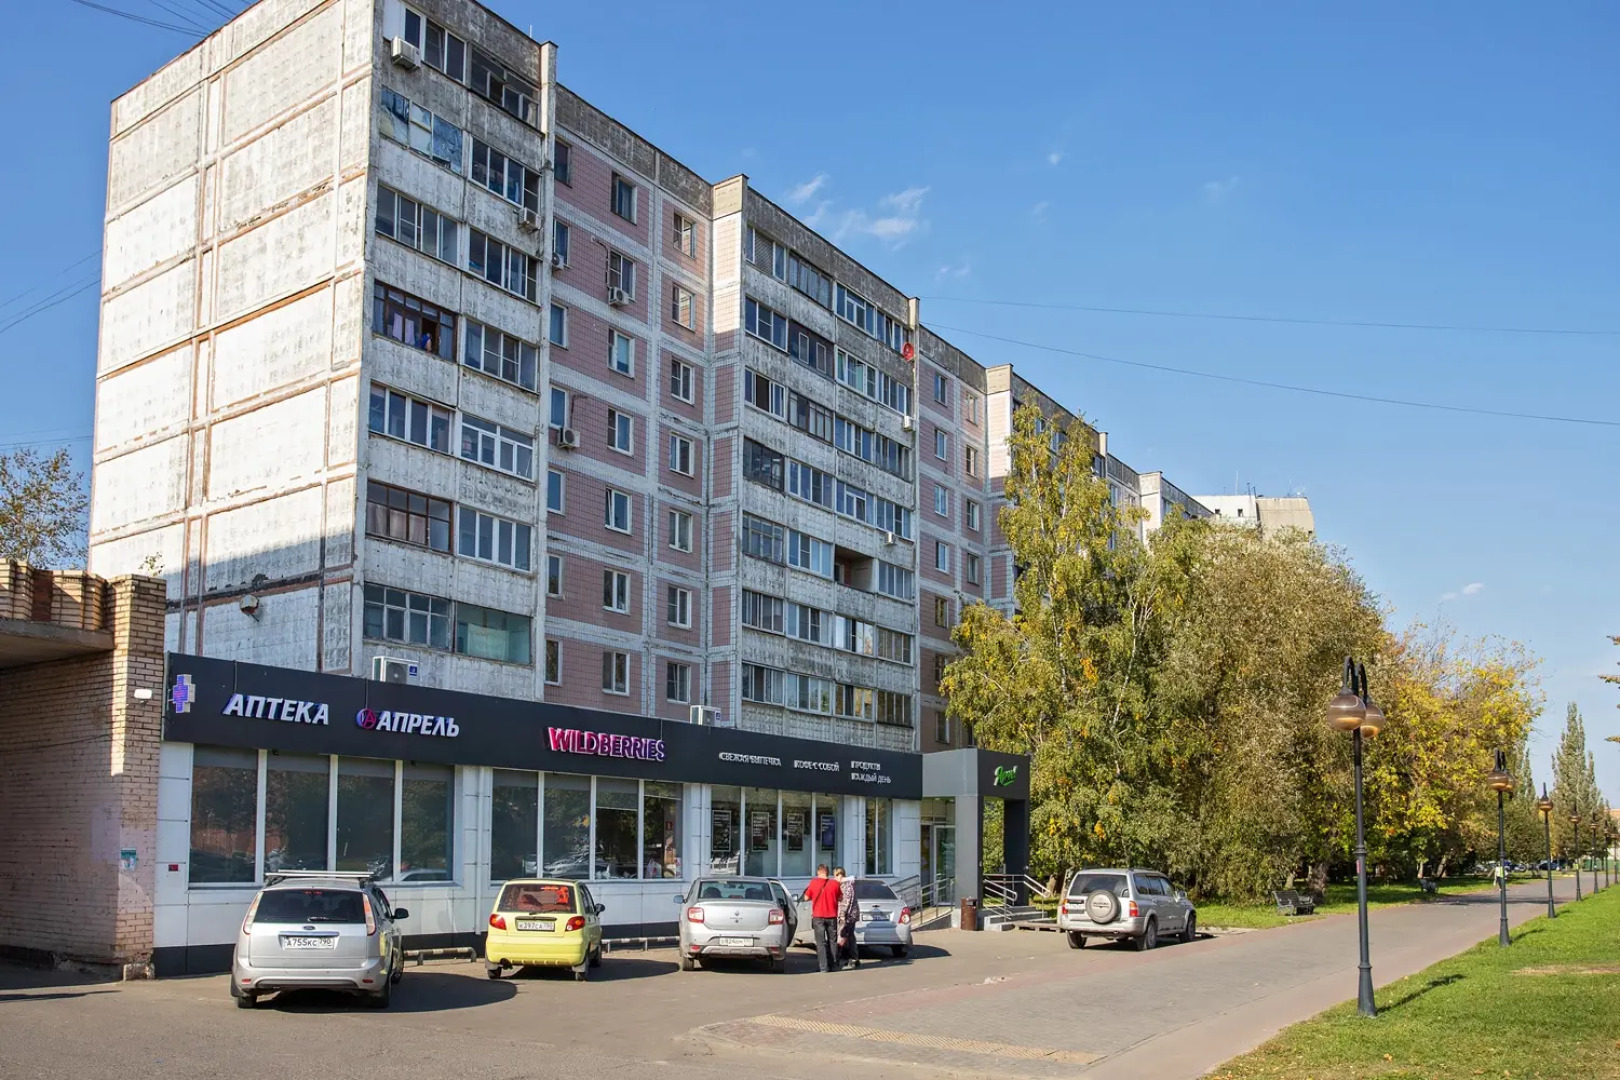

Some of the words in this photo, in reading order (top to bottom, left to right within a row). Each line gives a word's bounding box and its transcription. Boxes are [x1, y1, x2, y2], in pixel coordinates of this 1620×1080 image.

[222, 693, 329, 725] АПТЕКА
[376, 710, 460, 738] АПРЕЛЬ
[547, 726, 666, 762] WILDBERRIES
[794, 760, 812, 770] КОФЕ
[818, 761, 840, 772] СОБОЙ
[851, 772, 877, 782] КАЖДЫЙ
[877, 775, 892, 784] ДЕНЬ
